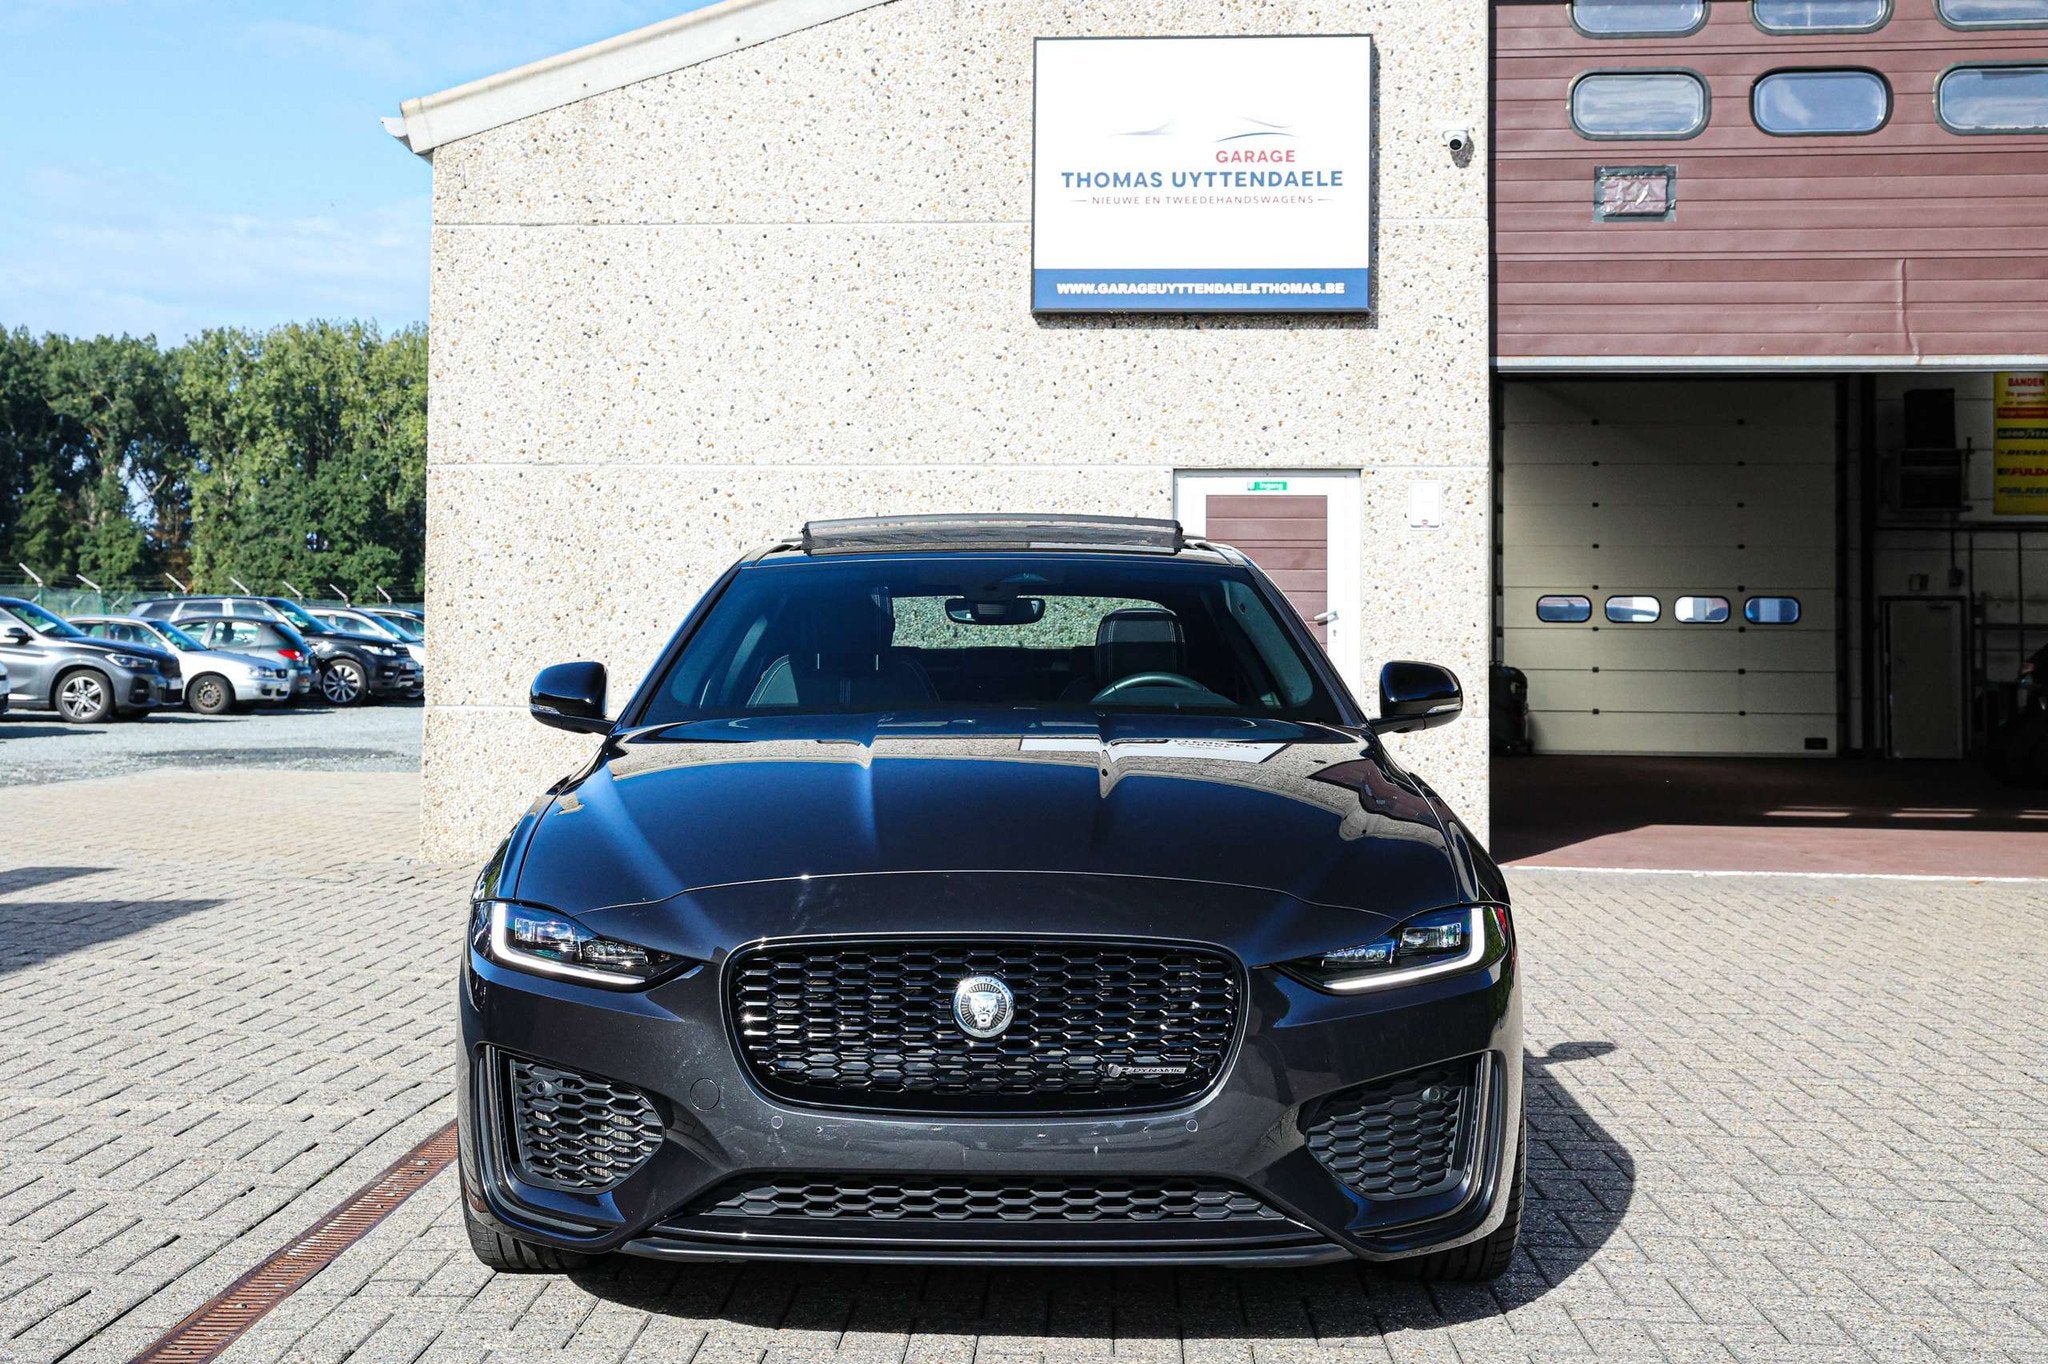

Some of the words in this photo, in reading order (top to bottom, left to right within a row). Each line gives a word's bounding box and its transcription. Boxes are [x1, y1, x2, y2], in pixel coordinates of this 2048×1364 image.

[1215, 149, 1296, 163] GARAGE
[1061, 171, 1163, 188] THOMAS
[1171, 170, 1344, 188] UYTTENDAELE
[1091, 196, 1140, 205] NIEUWE
[1145, 196, 1161, 205] EN
[1166, 194, 1315, 205] TWEEDEHANDSWAGENS
[1056, 282, 1346, 295] WWW.GARAGEUYTTENDAELETHOMAS.BE
